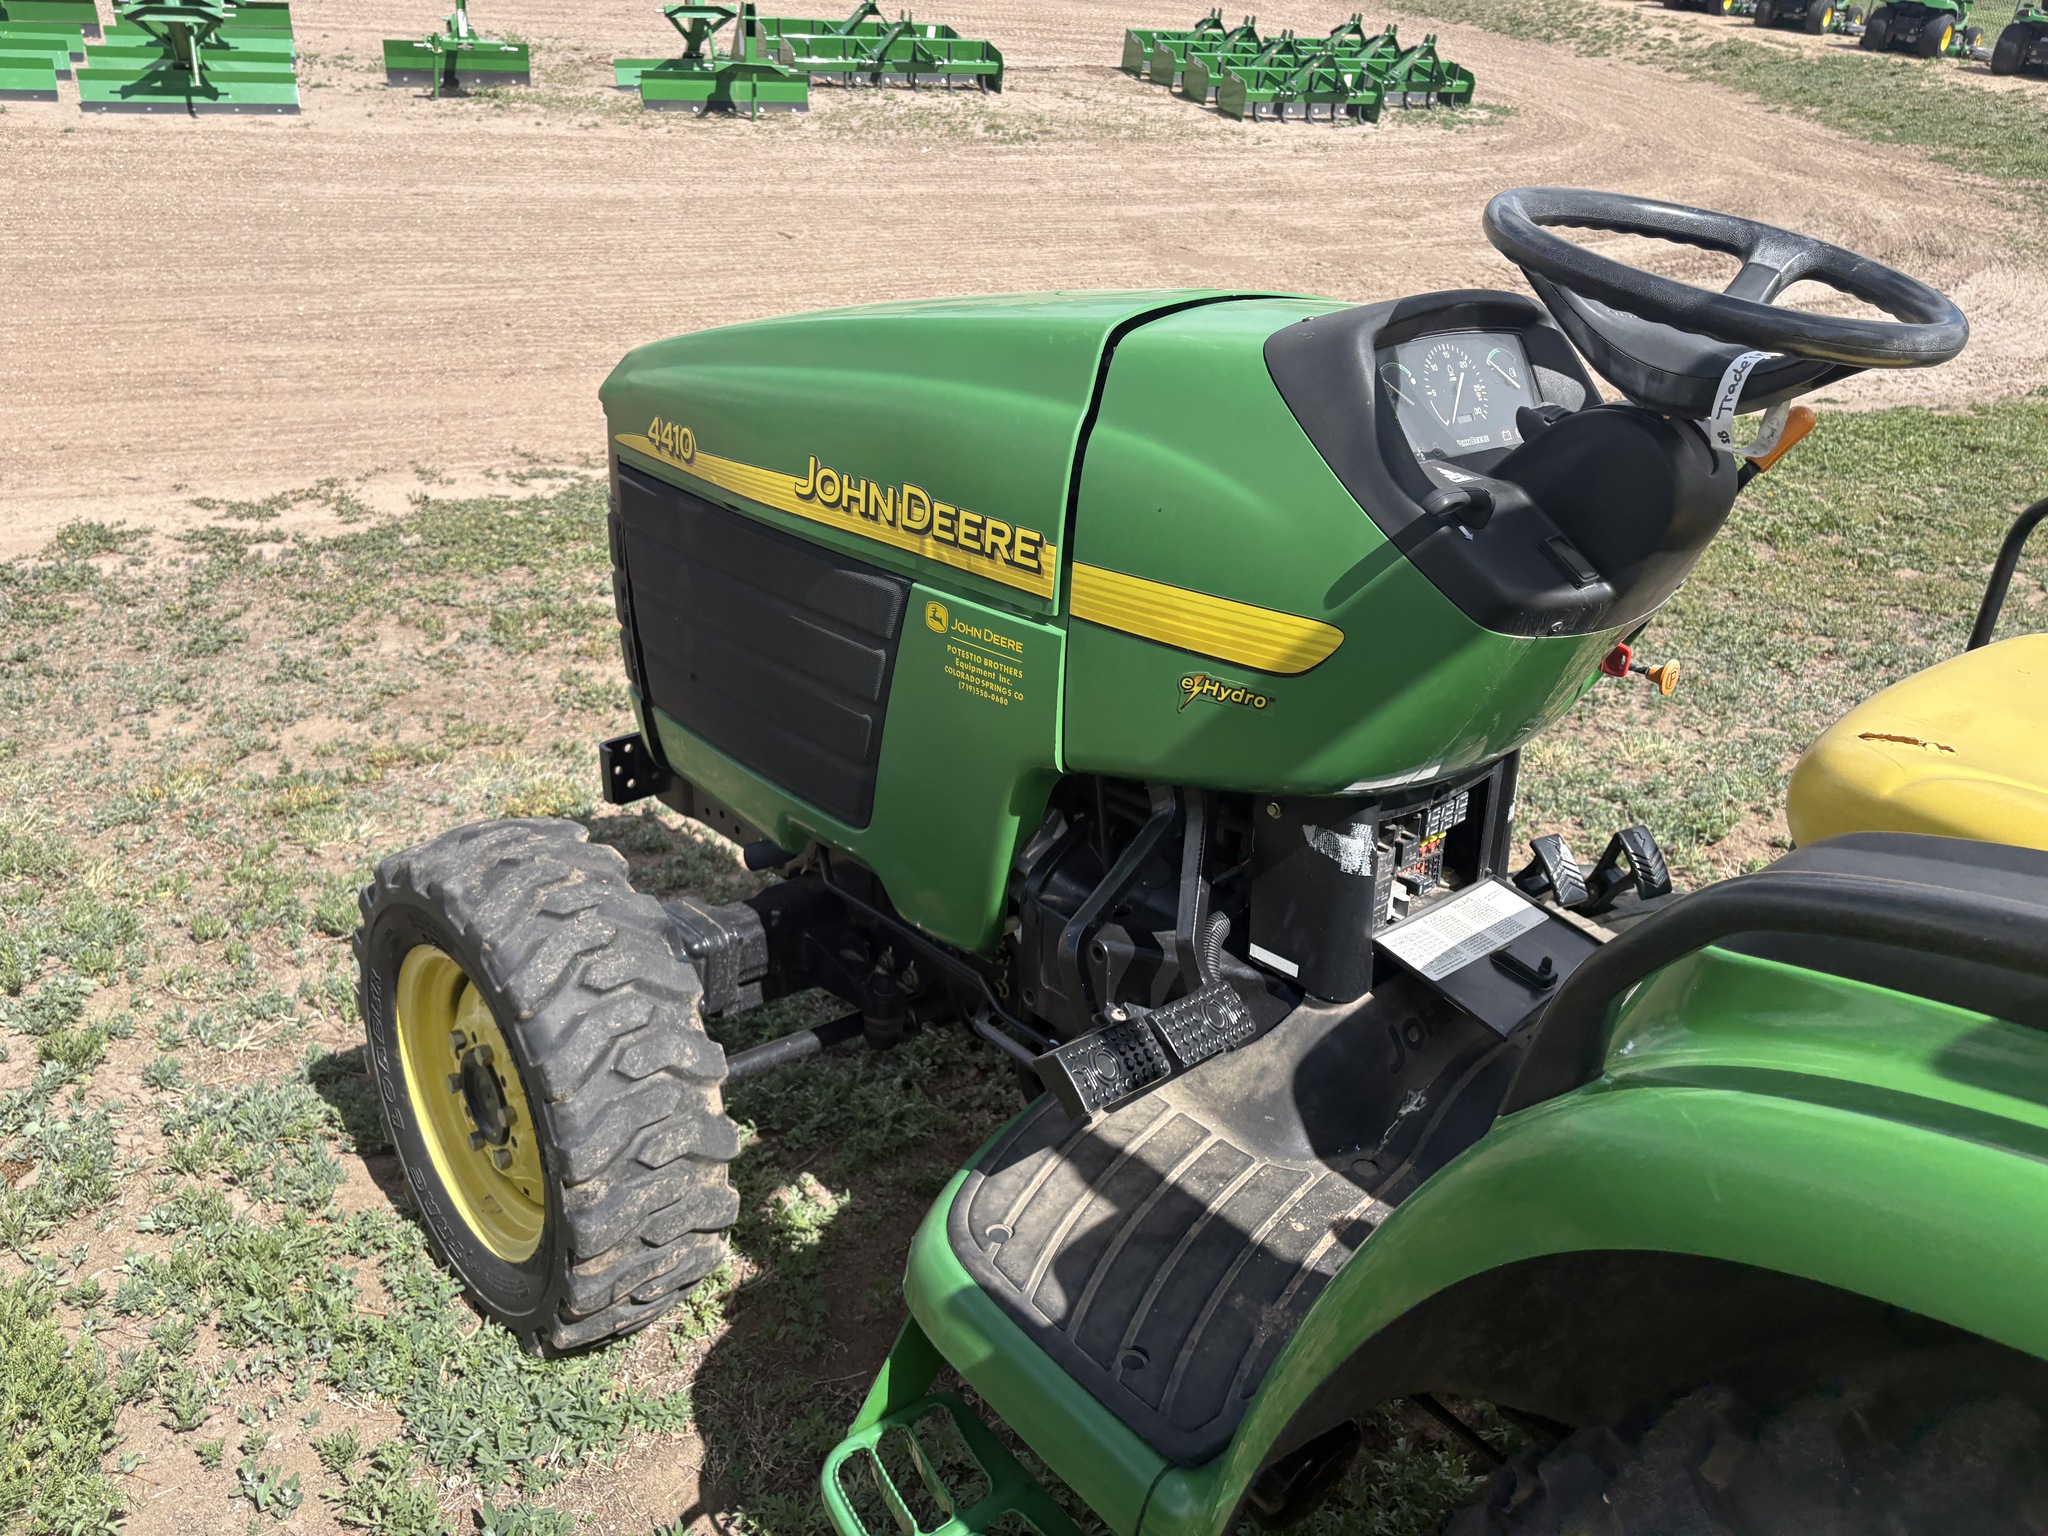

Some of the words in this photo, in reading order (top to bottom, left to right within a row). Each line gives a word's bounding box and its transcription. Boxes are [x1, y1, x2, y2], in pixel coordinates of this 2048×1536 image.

[1459, 360, 1468, 368] 20
[1716, 360, 1752, 420] Trade
[1474, 407, 1482, 415] 30
[647, 414, 696, 464] 4410
[794, 453, 900, 526] JOHN
[900, 481, 1046, 574] DEERE
[951, 618, 982, 639] JOHN
[983, 628, 1024, 654] DEERE
[947, 644, 982, 664] POTESTIO
[983, 657, 1023, 679] BROTHERS
[955, 657, 996, 680] Equipment
[998, 673, 1013, 686] Inc.
[944, 665, 980, 685] COLORADO
[981, 679, 1012, 697] SPRINGS
[1013, 691, 1024, 701] CO
